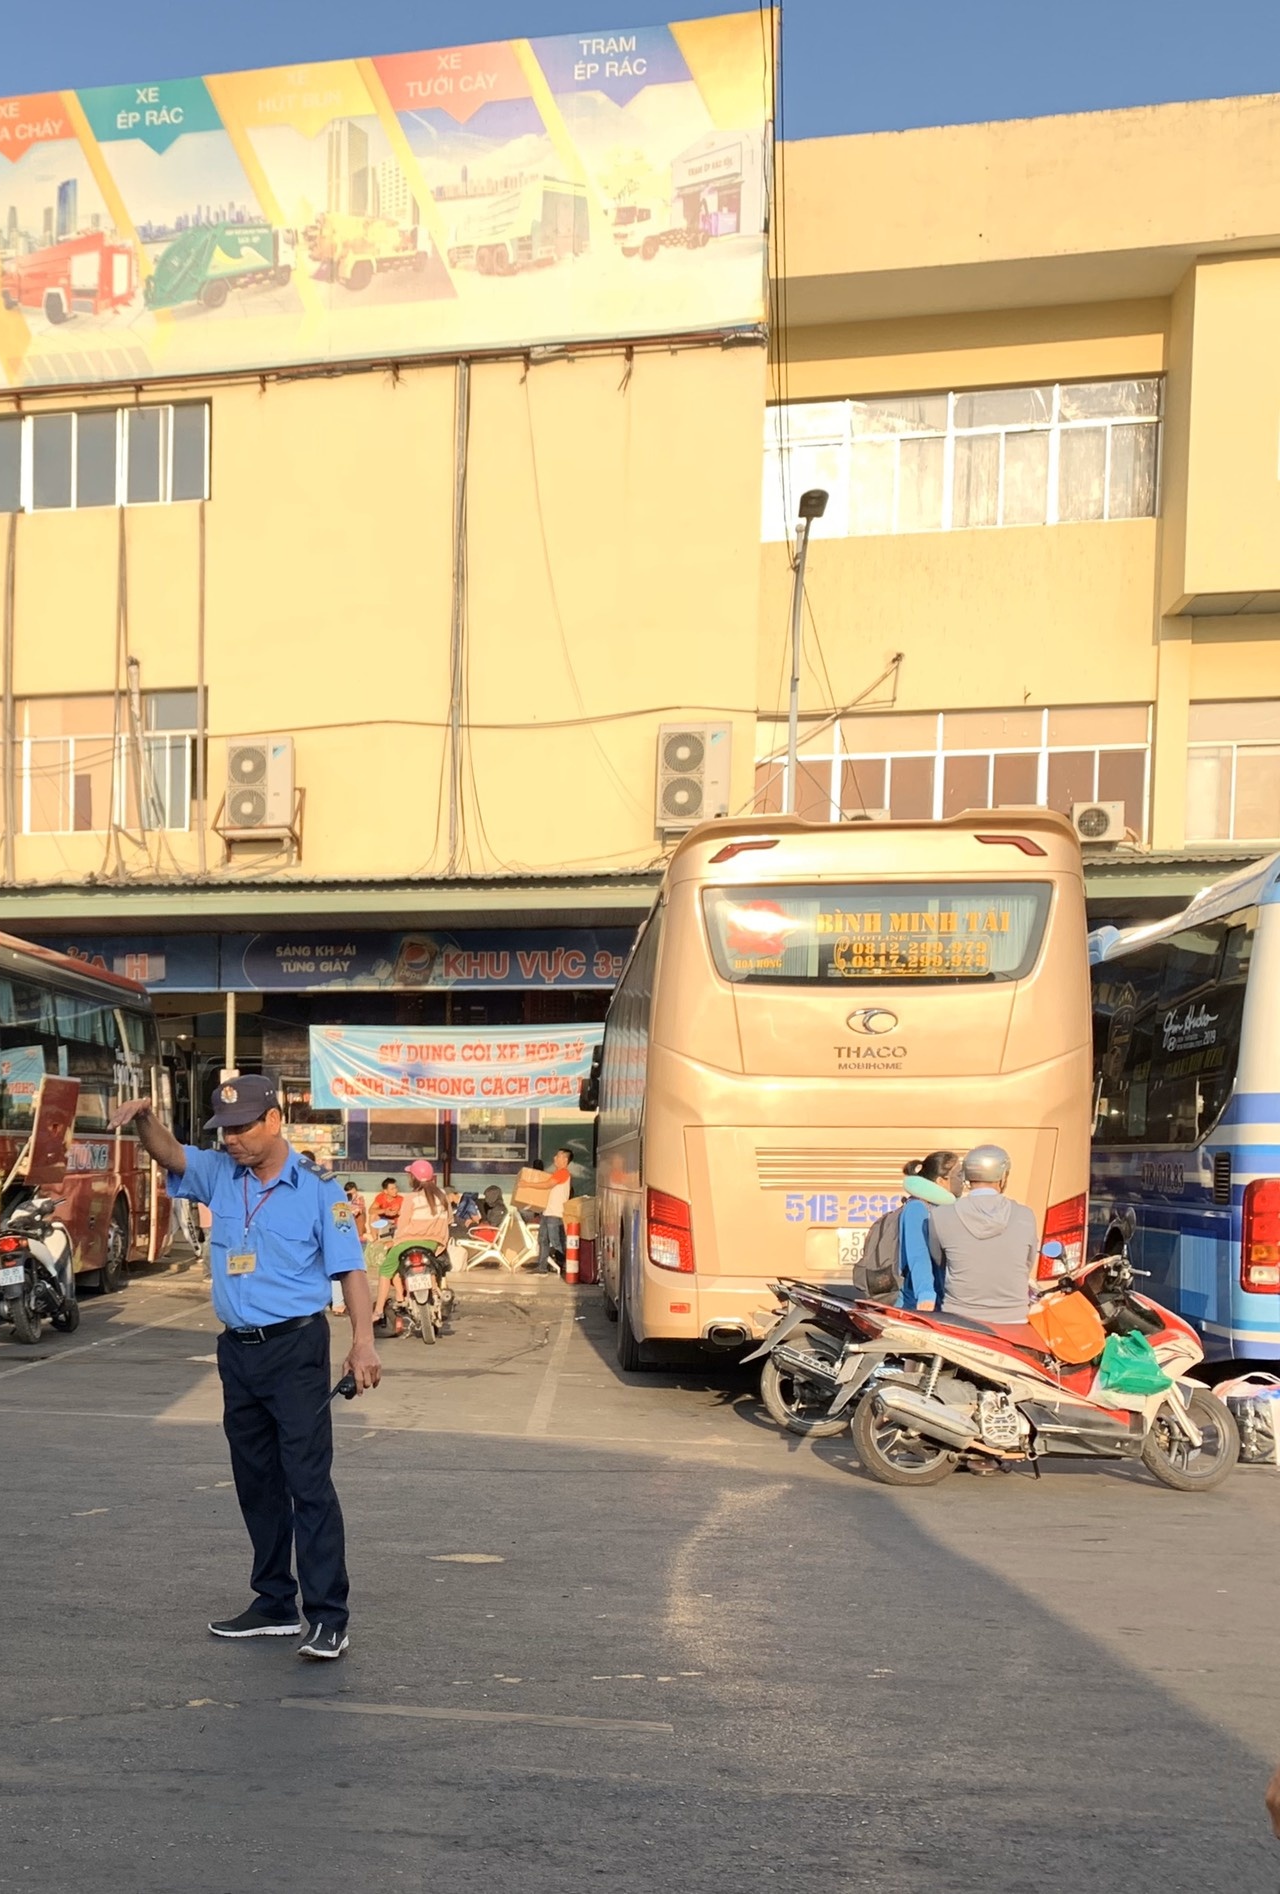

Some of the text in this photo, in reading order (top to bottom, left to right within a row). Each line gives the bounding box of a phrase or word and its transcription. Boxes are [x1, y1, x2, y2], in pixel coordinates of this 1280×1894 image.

[579, 35, 637, 56] TRẠM
[436, 52, 462, 70] XE
[574, 56, 648, 80] ÉP RÁC
[135, 87, 160, 104] XE
[116, 105, 184, 129] ÉP RÁC
[815, 908, 882, 934] BÌNH
[888, 911, 959, 934] MINH
[851, 941, 988, 955] 0812.299.979
[442, 951, 511, 980] KHU
[516, 947, 587, 984] VỰC
[851, 955, 988, 969] 0817.299.979
[497, 1042, 520, 1061] XE
[833, 1046, 908, 1058] THACO
[838, 1062, 903, 1070] MOBIHOME
[415, 1075, 475, 1096] PHONG
[480, 1072, 530, 1096] CÁCH
[534, 1069, 572, 1096] CỦA
[821, 1302, 842, 1314] YAMAHA
